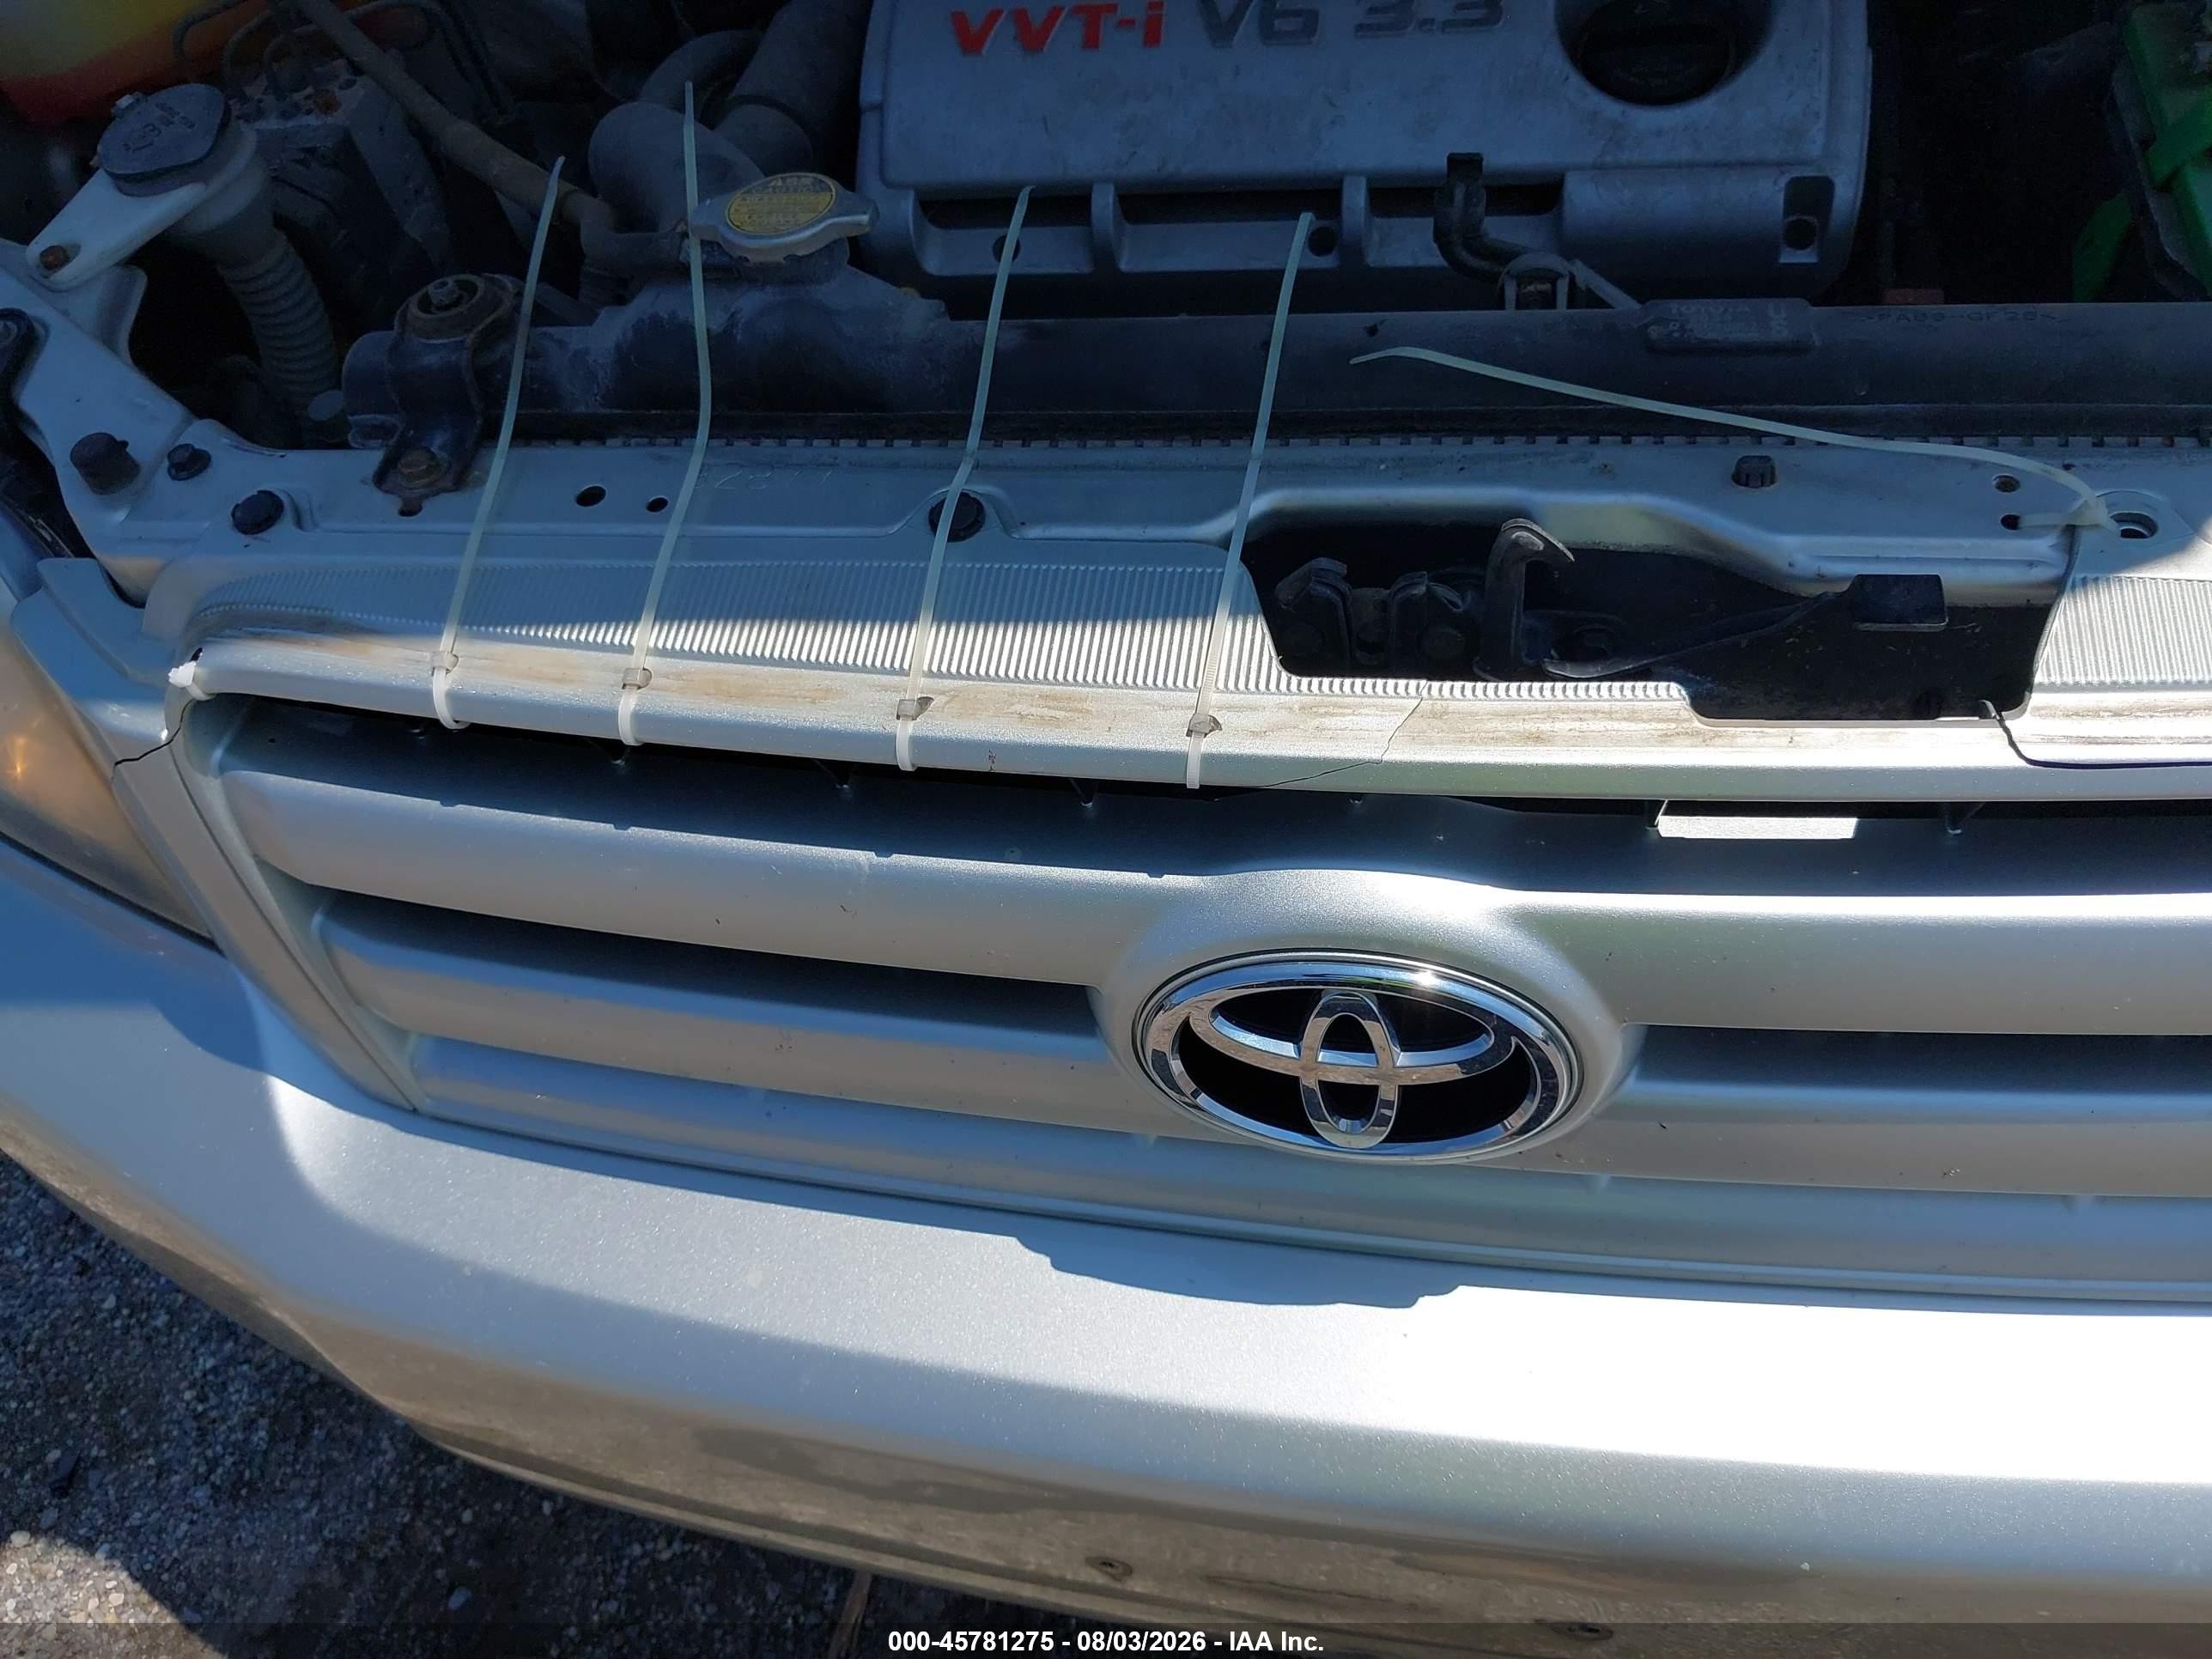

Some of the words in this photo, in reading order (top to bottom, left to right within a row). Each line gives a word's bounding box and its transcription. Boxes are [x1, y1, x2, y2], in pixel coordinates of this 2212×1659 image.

[950, 1, 1165, 56] VVT-i
[1196, 0, 1321, 48] V6
[1354, 0, 1505, 40] 3.3
